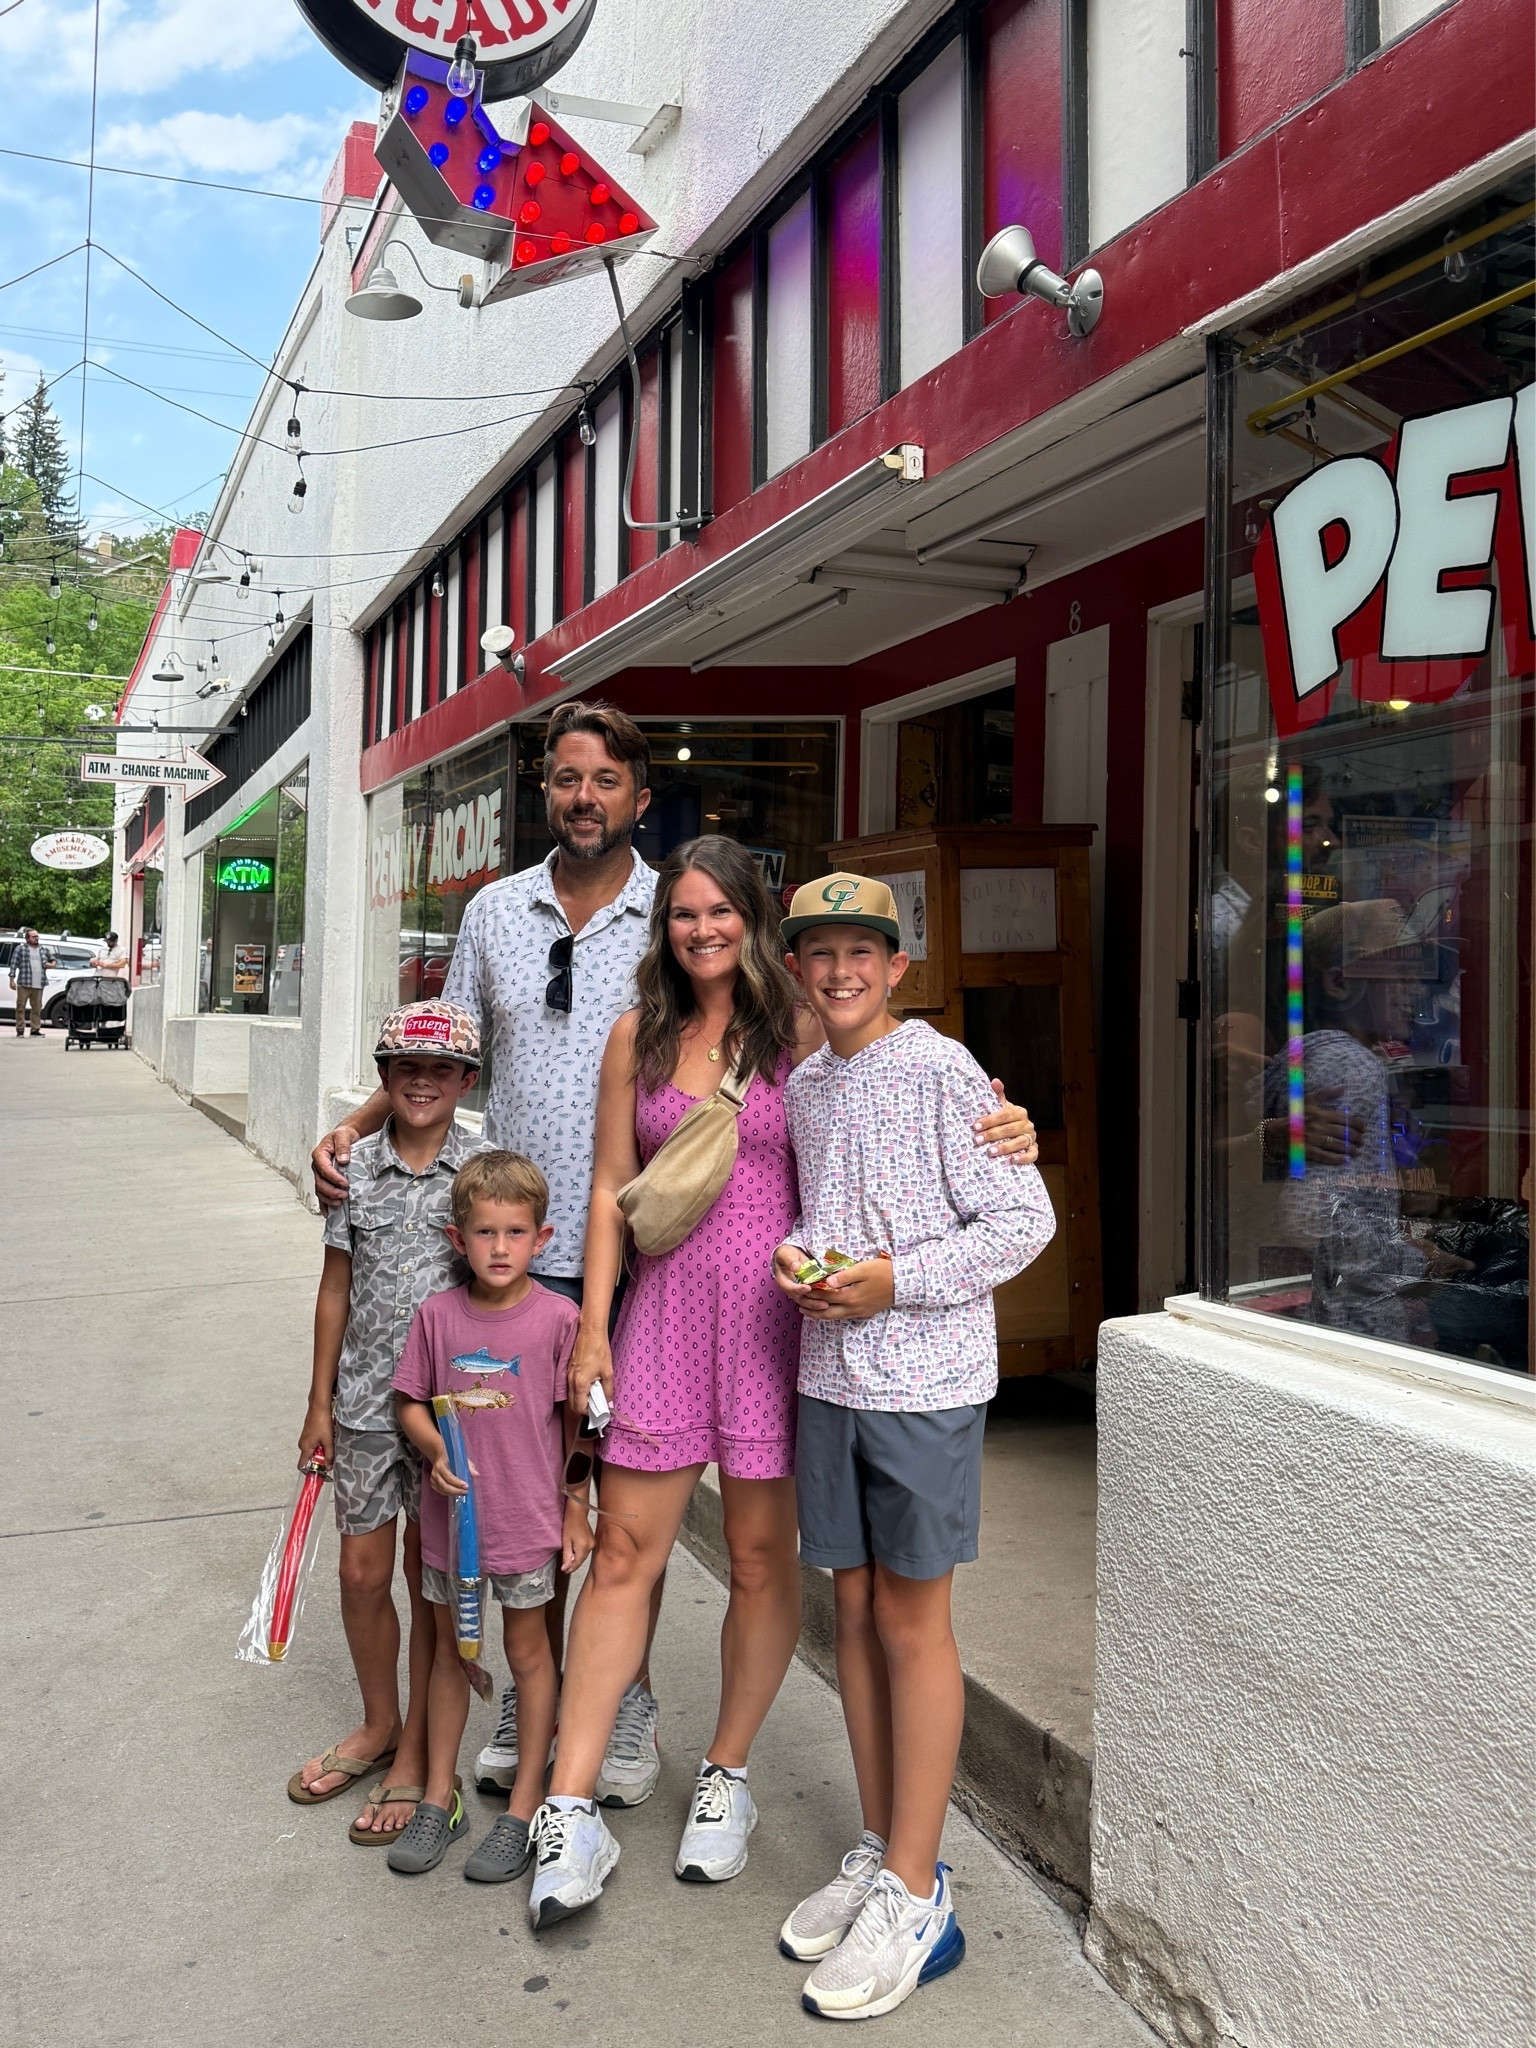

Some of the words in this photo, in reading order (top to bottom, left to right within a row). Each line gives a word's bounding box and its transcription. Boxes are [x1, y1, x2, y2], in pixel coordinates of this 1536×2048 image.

[366, 0, 572, 47] CAD
[1268, 378, 1536, 702] PE
[1069, 600, 1081, 635] 8
[88, 761, 110, 774] ATM
[121, 763, 161, 778] CHANGE
[163, 766, 210, 781] MACHINE
[55, 836, 87, 846] ARCADE
[370, 822, 427, 899] PENNY
[427, 787, 502, 890] ARCADE
[44, 845, 97, 860] AMUSEMENTS
[220, 866, 269, 884] ATM
[962, 878, 1048, 908] SOUVENIR
[979, 928, 1034, 944] COINS
[406, 1018, 450, 1032] Gruene
